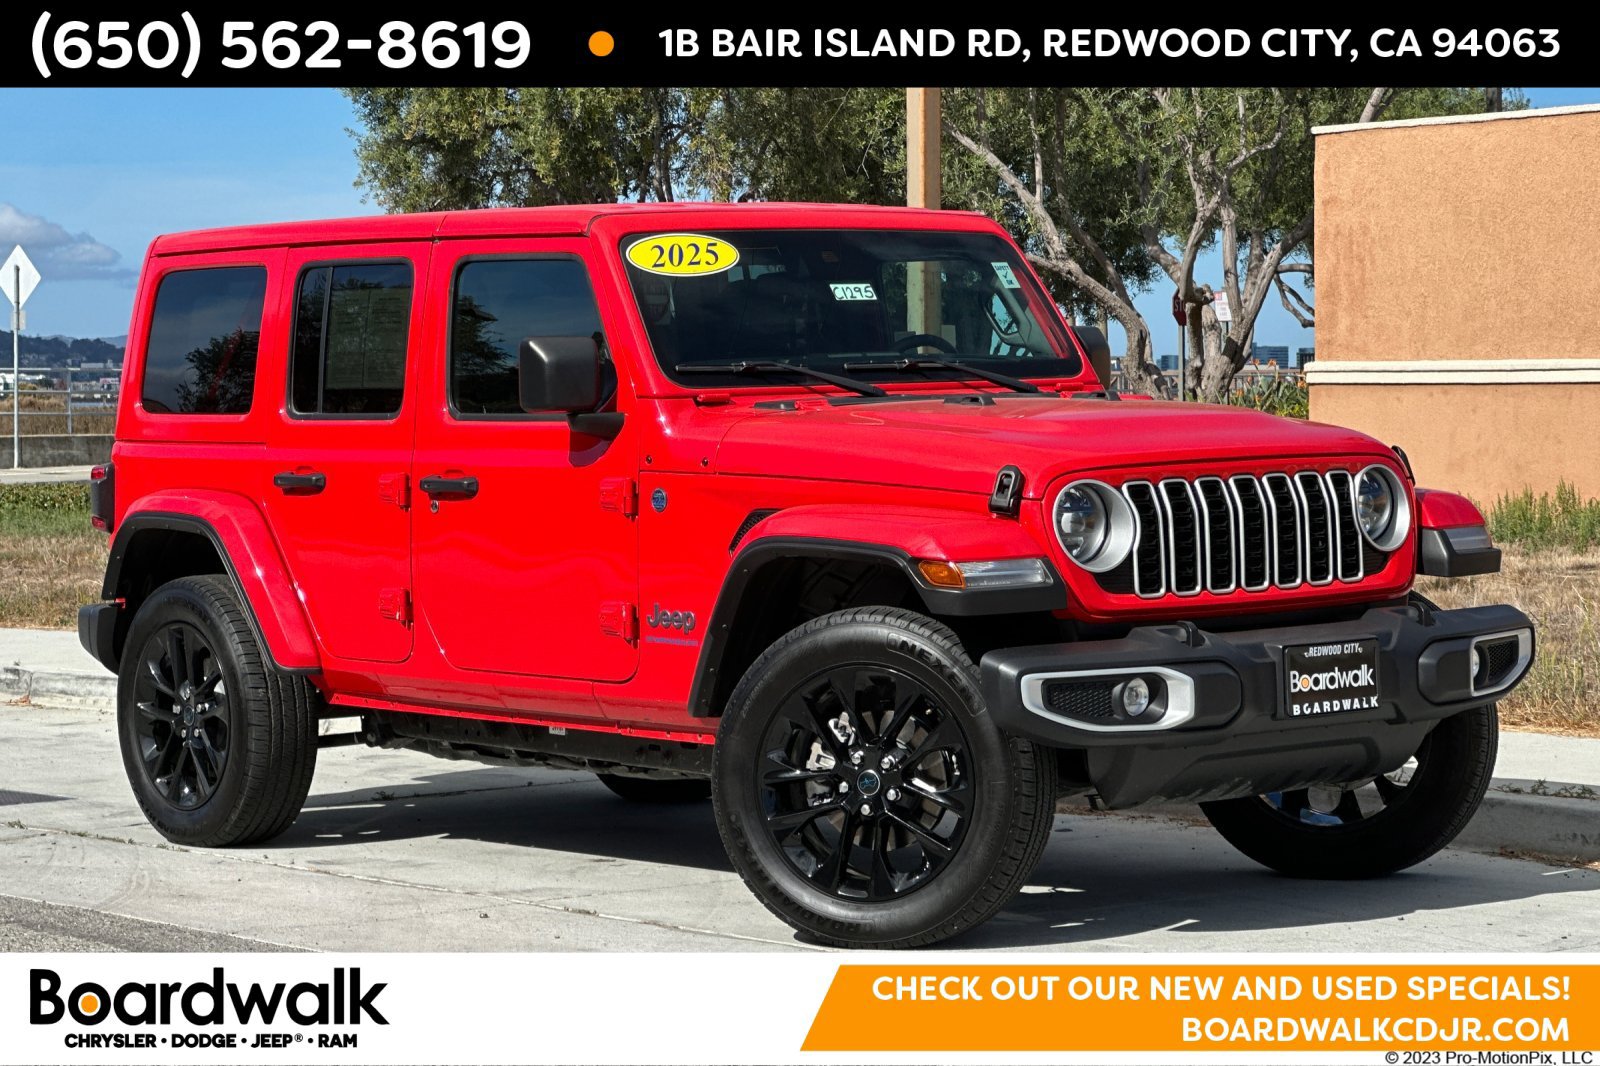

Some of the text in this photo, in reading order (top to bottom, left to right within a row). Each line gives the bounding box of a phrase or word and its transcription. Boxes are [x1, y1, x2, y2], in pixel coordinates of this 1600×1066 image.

[651, 242, 719, 268] 2025
[832, 285, 874, 300] C1295
[647, 602, 696, 634] Jeep
[1309, 642, 1360, 657] REDWOOD CITY
[1289, 664, 1375, 693] Boardwalk
